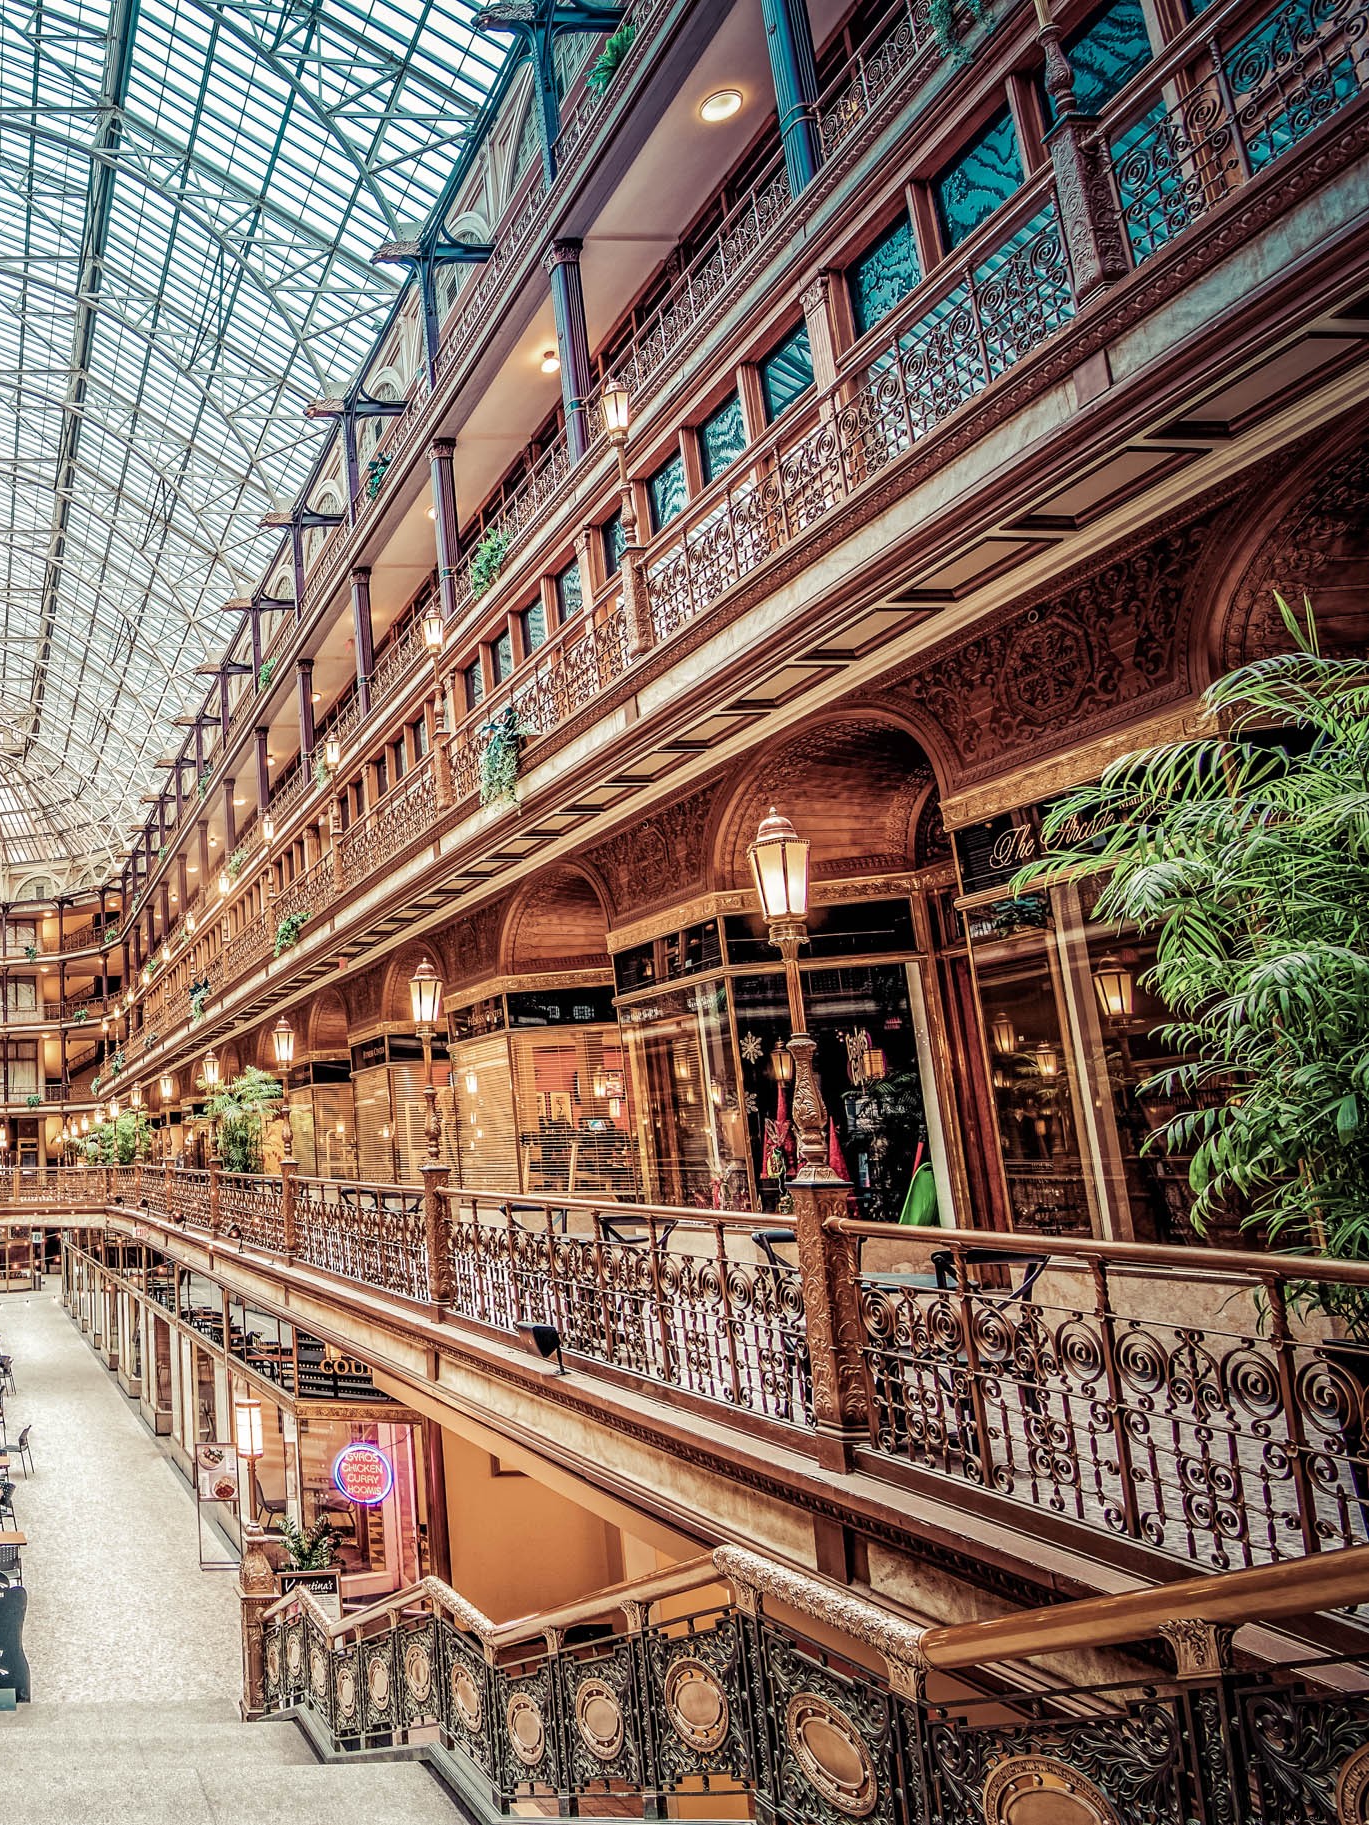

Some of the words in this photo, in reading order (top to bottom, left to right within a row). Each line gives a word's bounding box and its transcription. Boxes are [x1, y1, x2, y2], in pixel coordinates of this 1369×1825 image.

[989, 823, 1035, 868] The
[1040, 799, 1116, 852] Arcade
[320, 1359, 372, 1375] COU
[346, 1452, 379, 1462] GYROS
[341, 1462, 383, 1474] CHICKEN
[347, 1473, 379, 1484] CURRY
